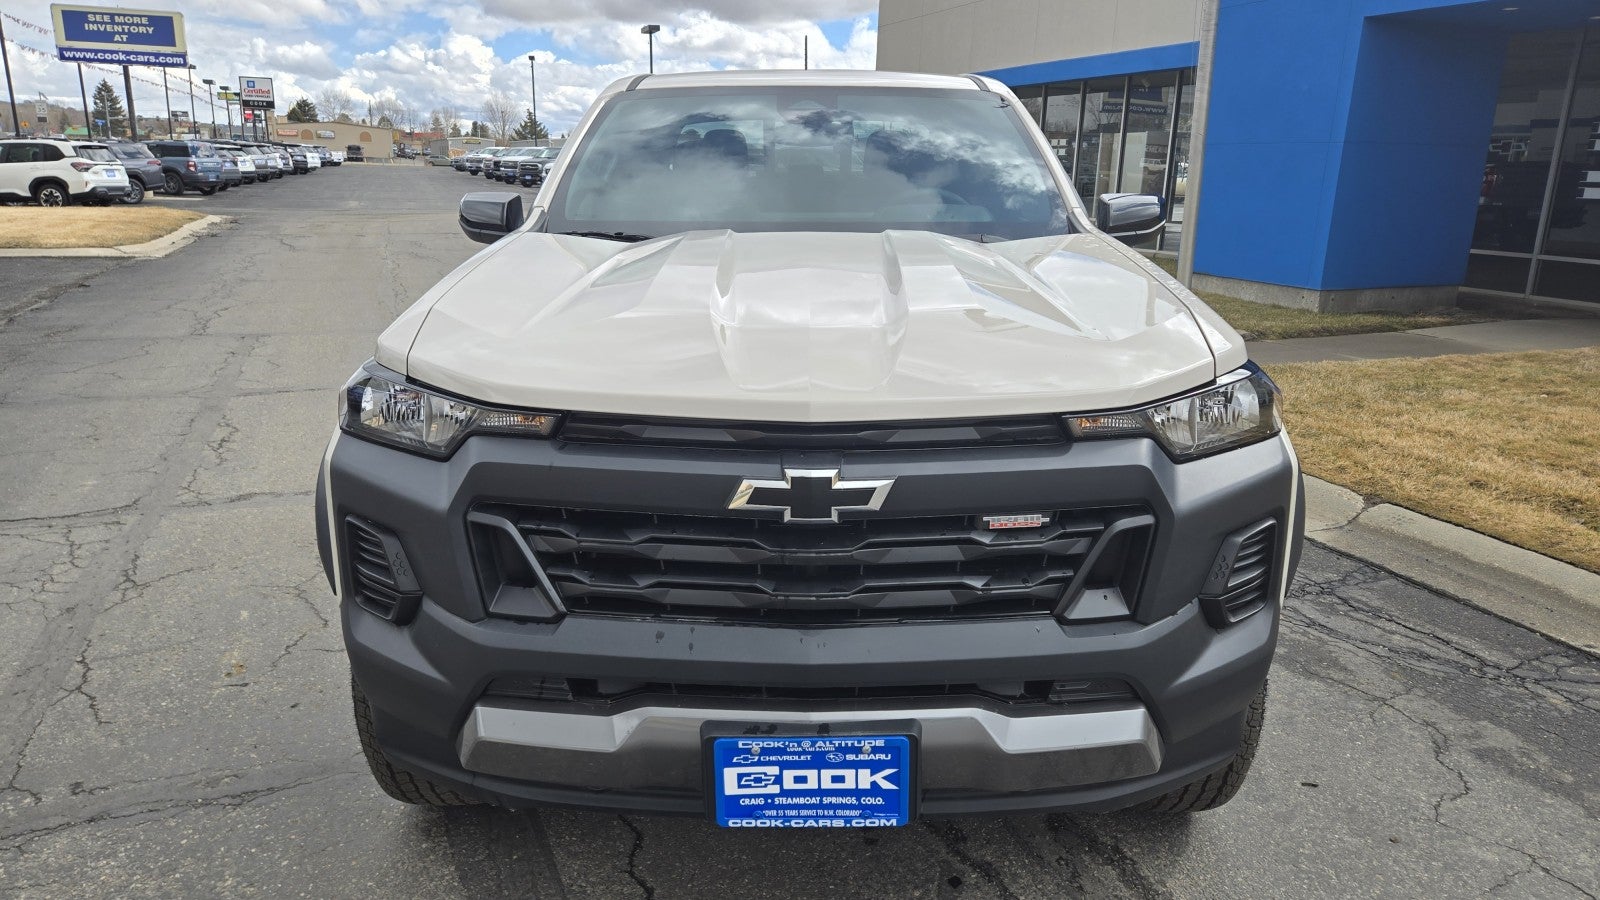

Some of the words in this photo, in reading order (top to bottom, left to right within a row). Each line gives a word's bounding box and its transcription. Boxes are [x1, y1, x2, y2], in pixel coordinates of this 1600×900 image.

[87, 14, 111, 22] SEE
[114, 15, 149, 24] MORE
[84, 23, 154, 34] INVENTORY
[113, 34, 128, 42] AT
[63, 51, 184, 64] www.cook-cars.com
[801, 740, 812, 748] @
[815, 739, 885, 748] ALTITUDE
[845, 753, 892, 761] SUBARU
[723, 766, 899, 795] COOK
[739, 797, 765, 805] CRAIG
[774, 797, 820, 805] STEAMBOAT
[822, 796, 859, 806] SPRINGS,
[860, 797, 885, 805] COLO.
[785, 809, 799, 817] YEARS
[728, 819, 897, 828] COOK-CARS.COM
